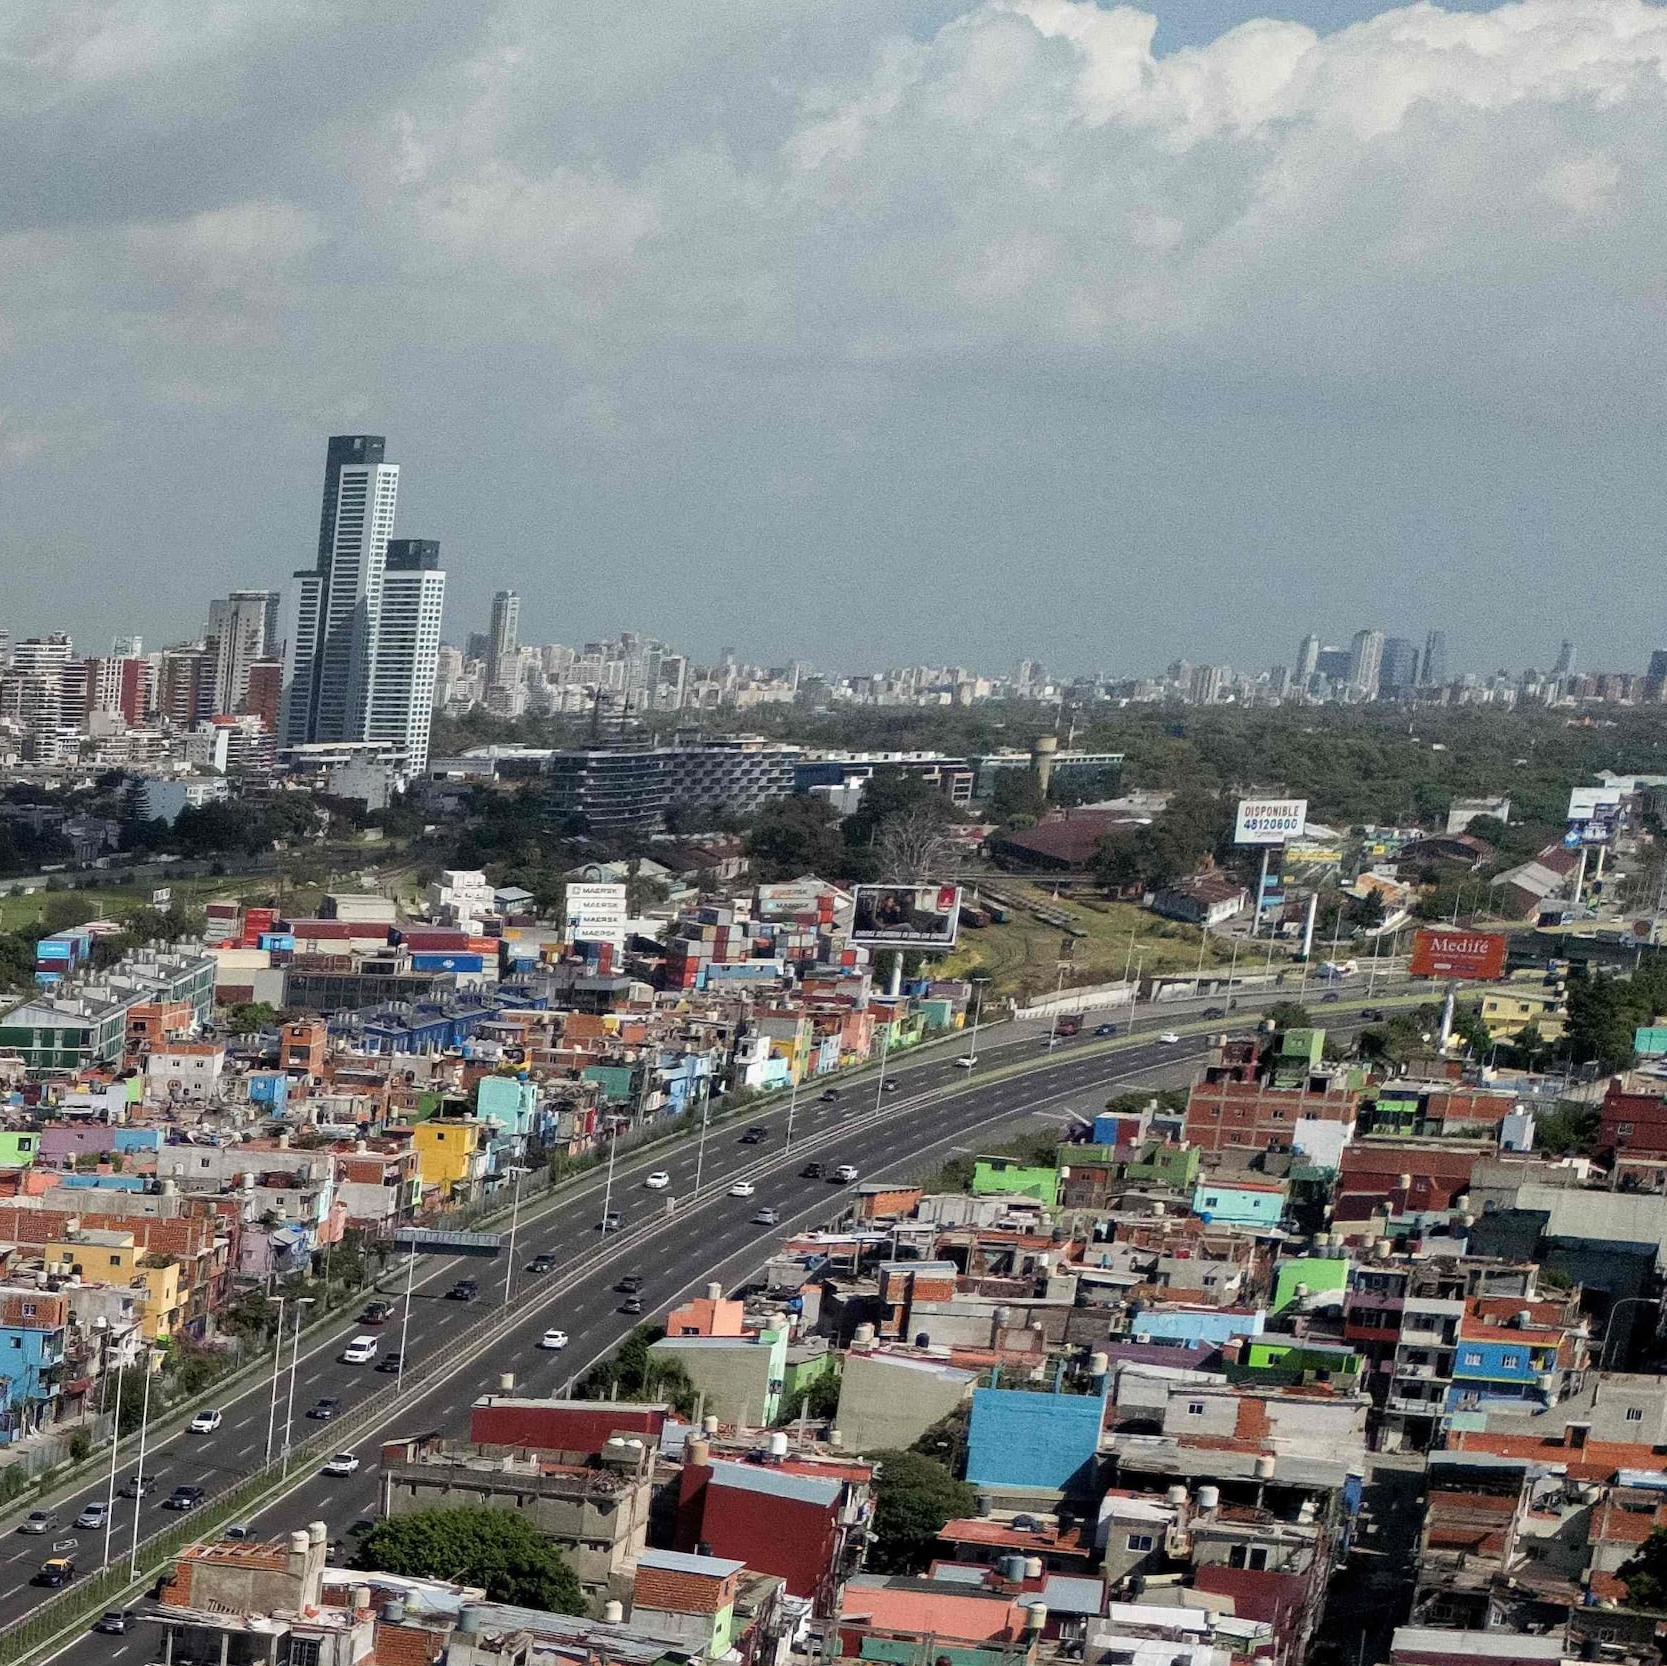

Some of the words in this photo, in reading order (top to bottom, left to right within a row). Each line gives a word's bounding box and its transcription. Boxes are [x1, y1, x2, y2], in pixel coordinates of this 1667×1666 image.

[1244, 805, 1300, 817] DISPONIBLE
[582, 887, 618, 895] MAERSK
[1430, 937, 1490, 954] Medifé
